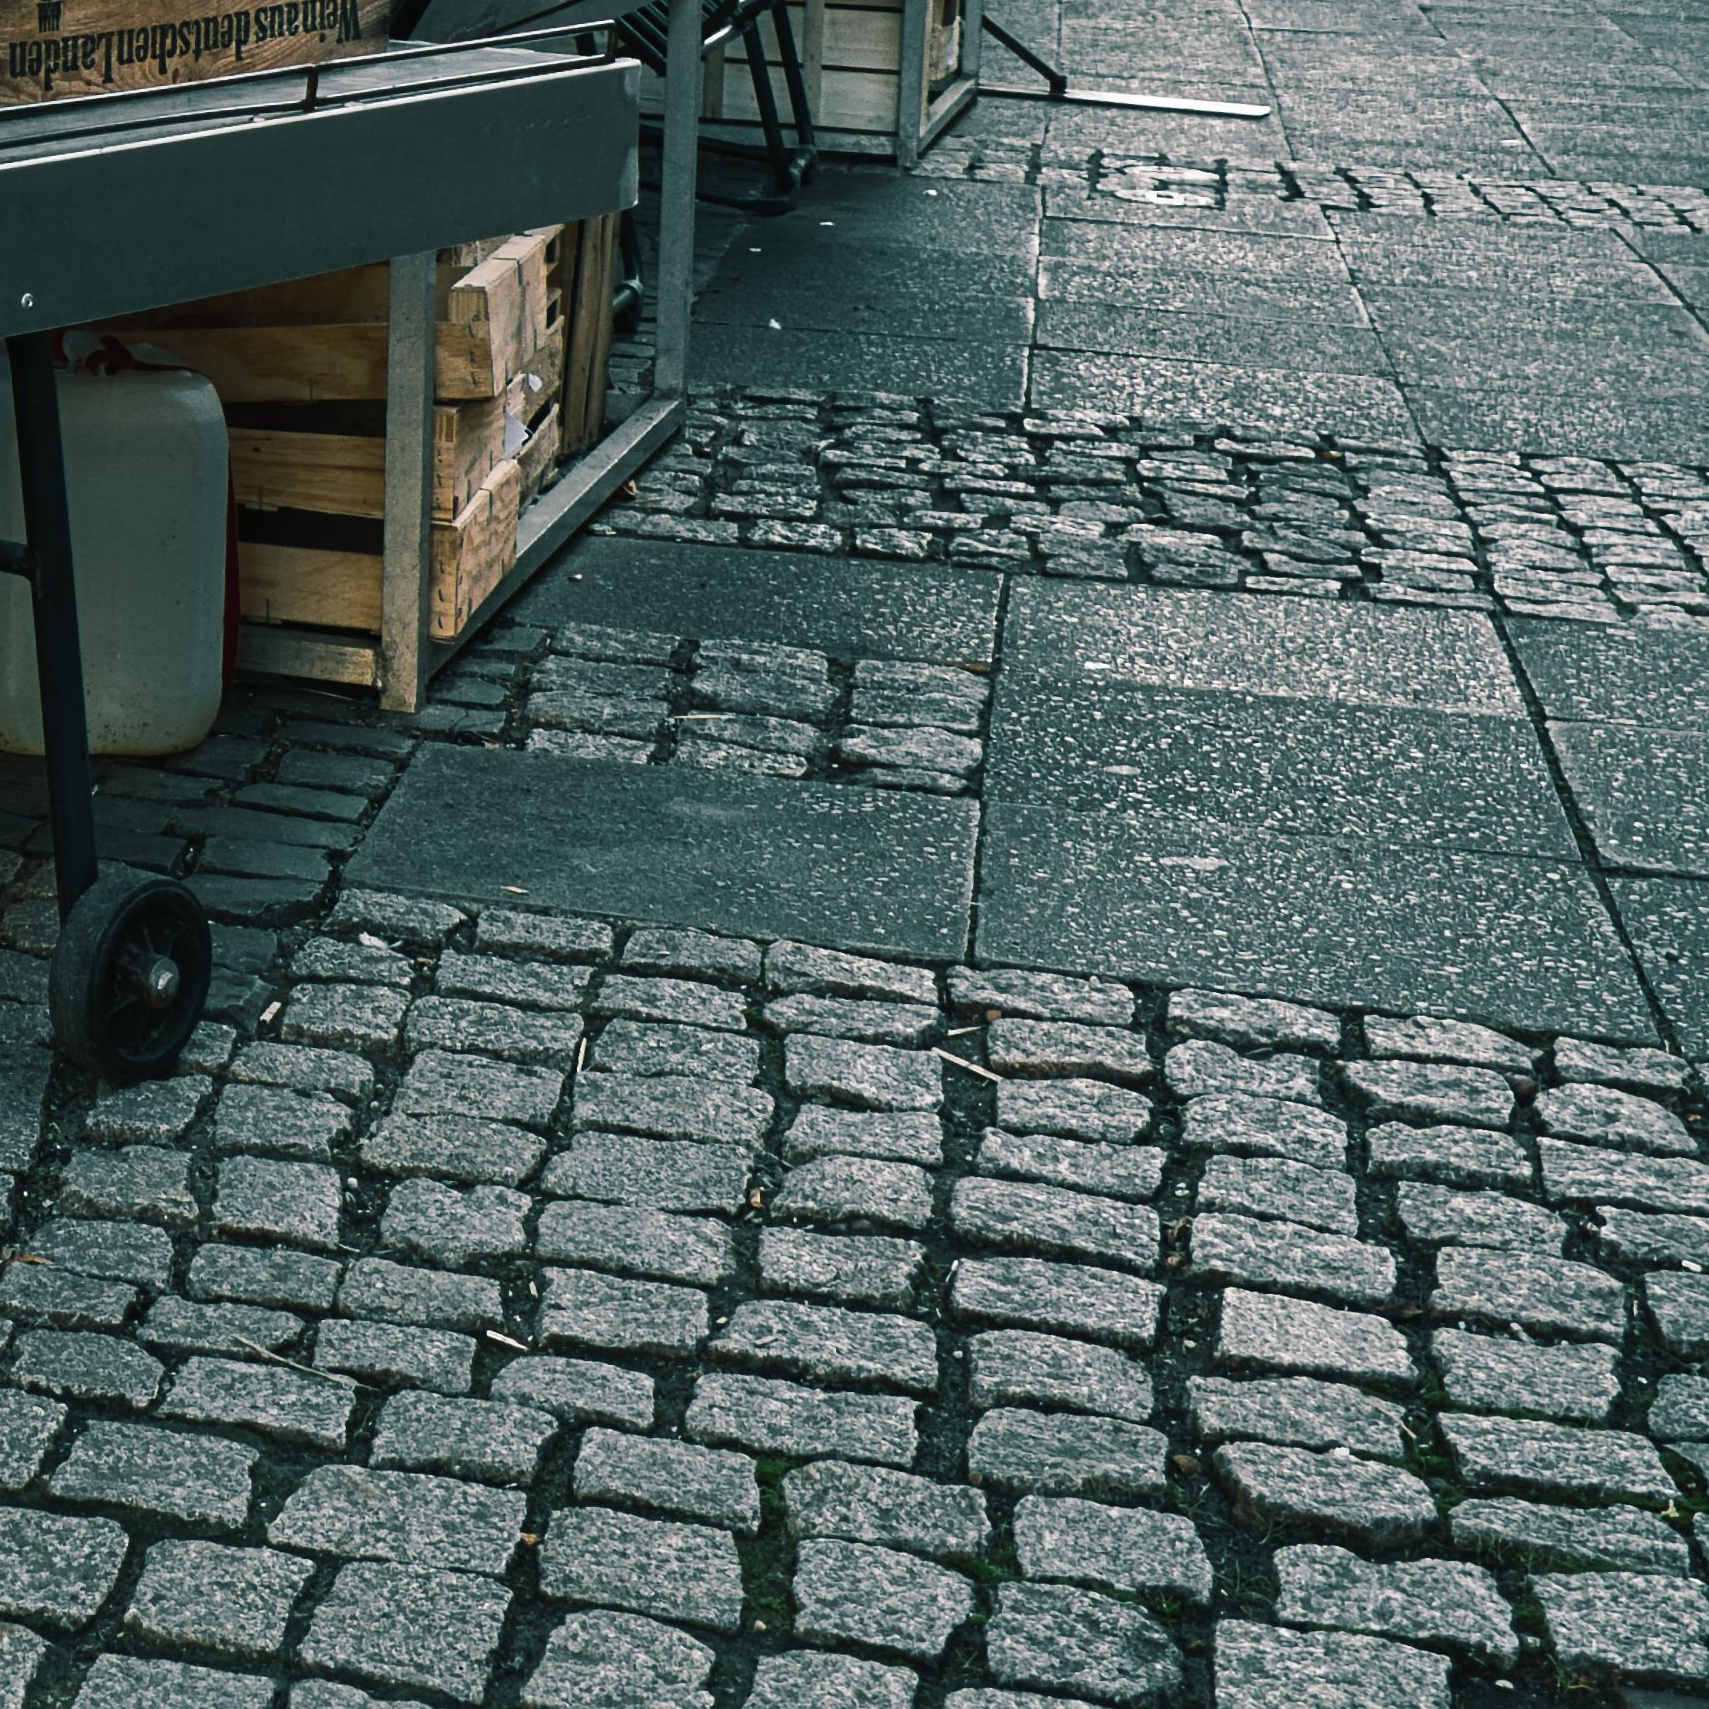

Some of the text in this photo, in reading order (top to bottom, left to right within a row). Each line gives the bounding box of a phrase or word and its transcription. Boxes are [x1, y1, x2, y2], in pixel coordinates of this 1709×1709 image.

[116, 9, 251, 75] deutschen
[253, 2, 301, 44] aus
[8, 30, 114, 92] Landen
